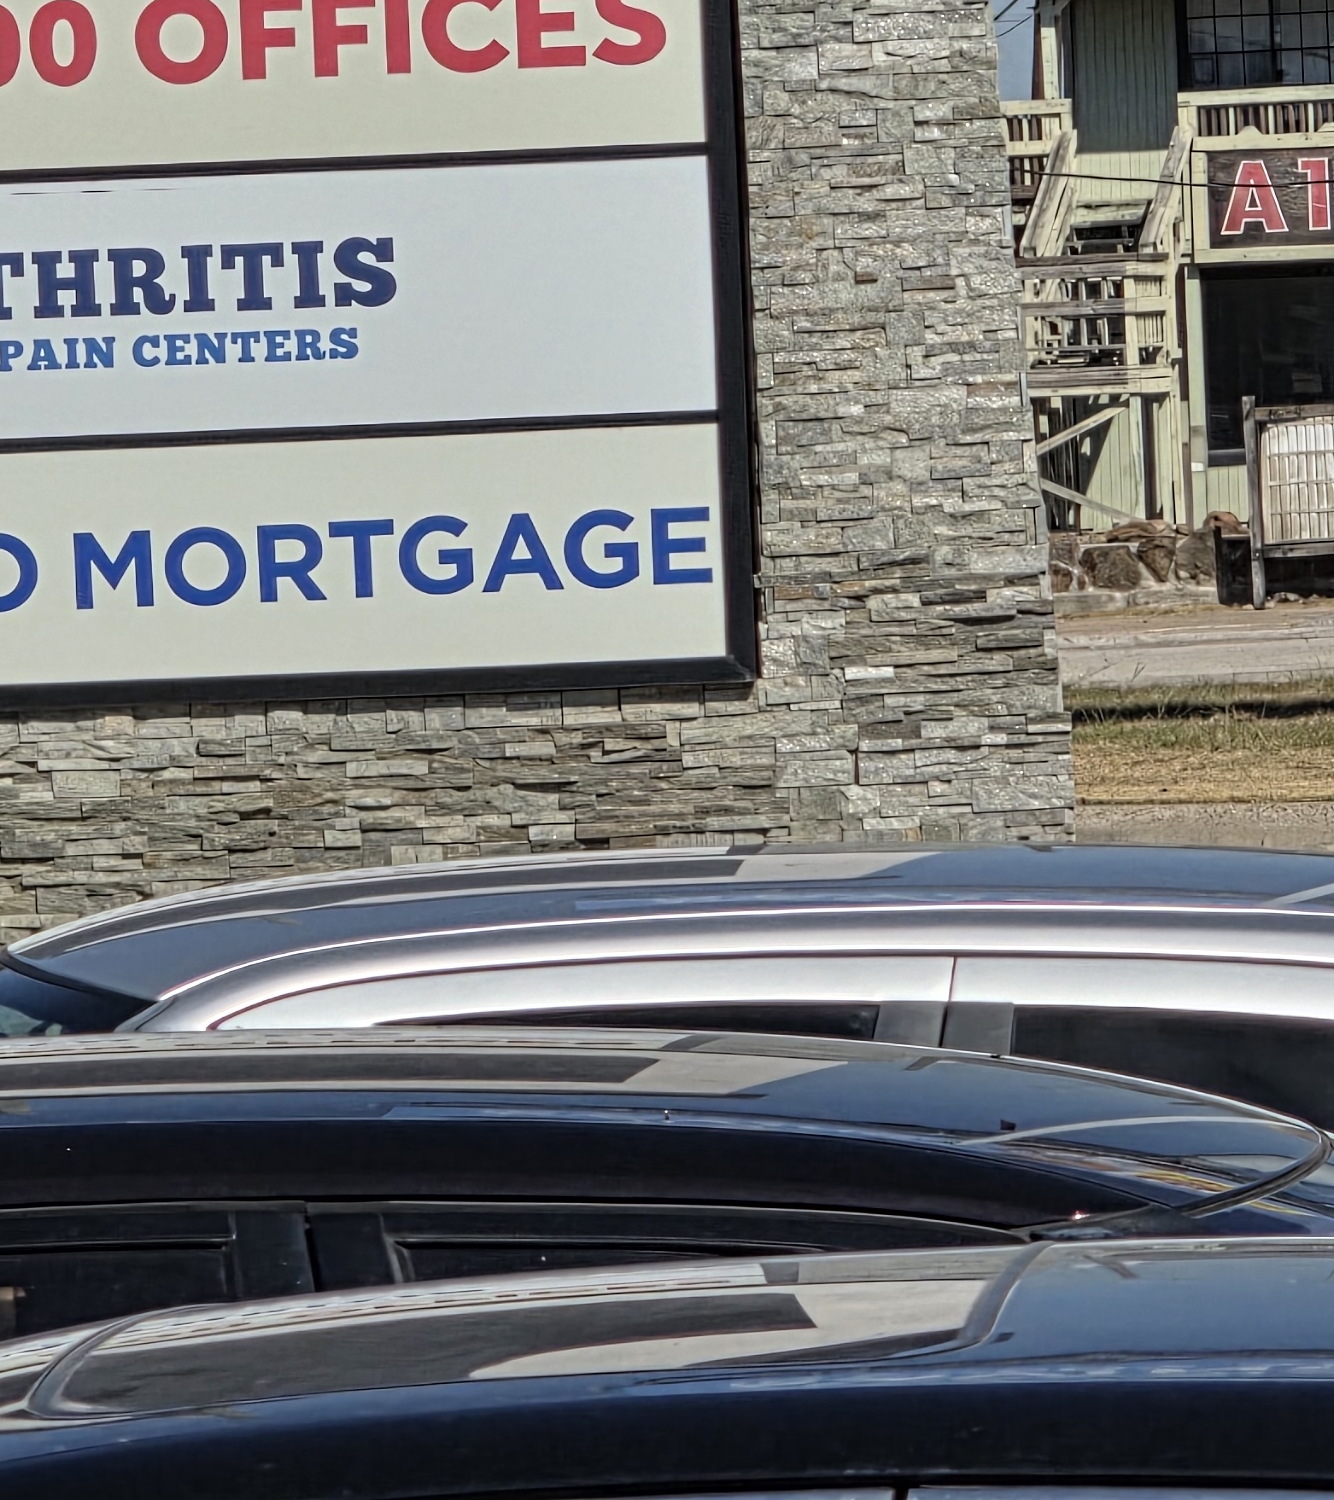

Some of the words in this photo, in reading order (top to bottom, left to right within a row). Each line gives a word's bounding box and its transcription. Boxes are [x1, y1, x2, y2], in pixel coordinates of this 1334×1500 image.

[1221, 157, 1331, 235] A1
[132, 326, 360, 368] CENTERS
[73, 506, 713, 610] MORTGAGE
